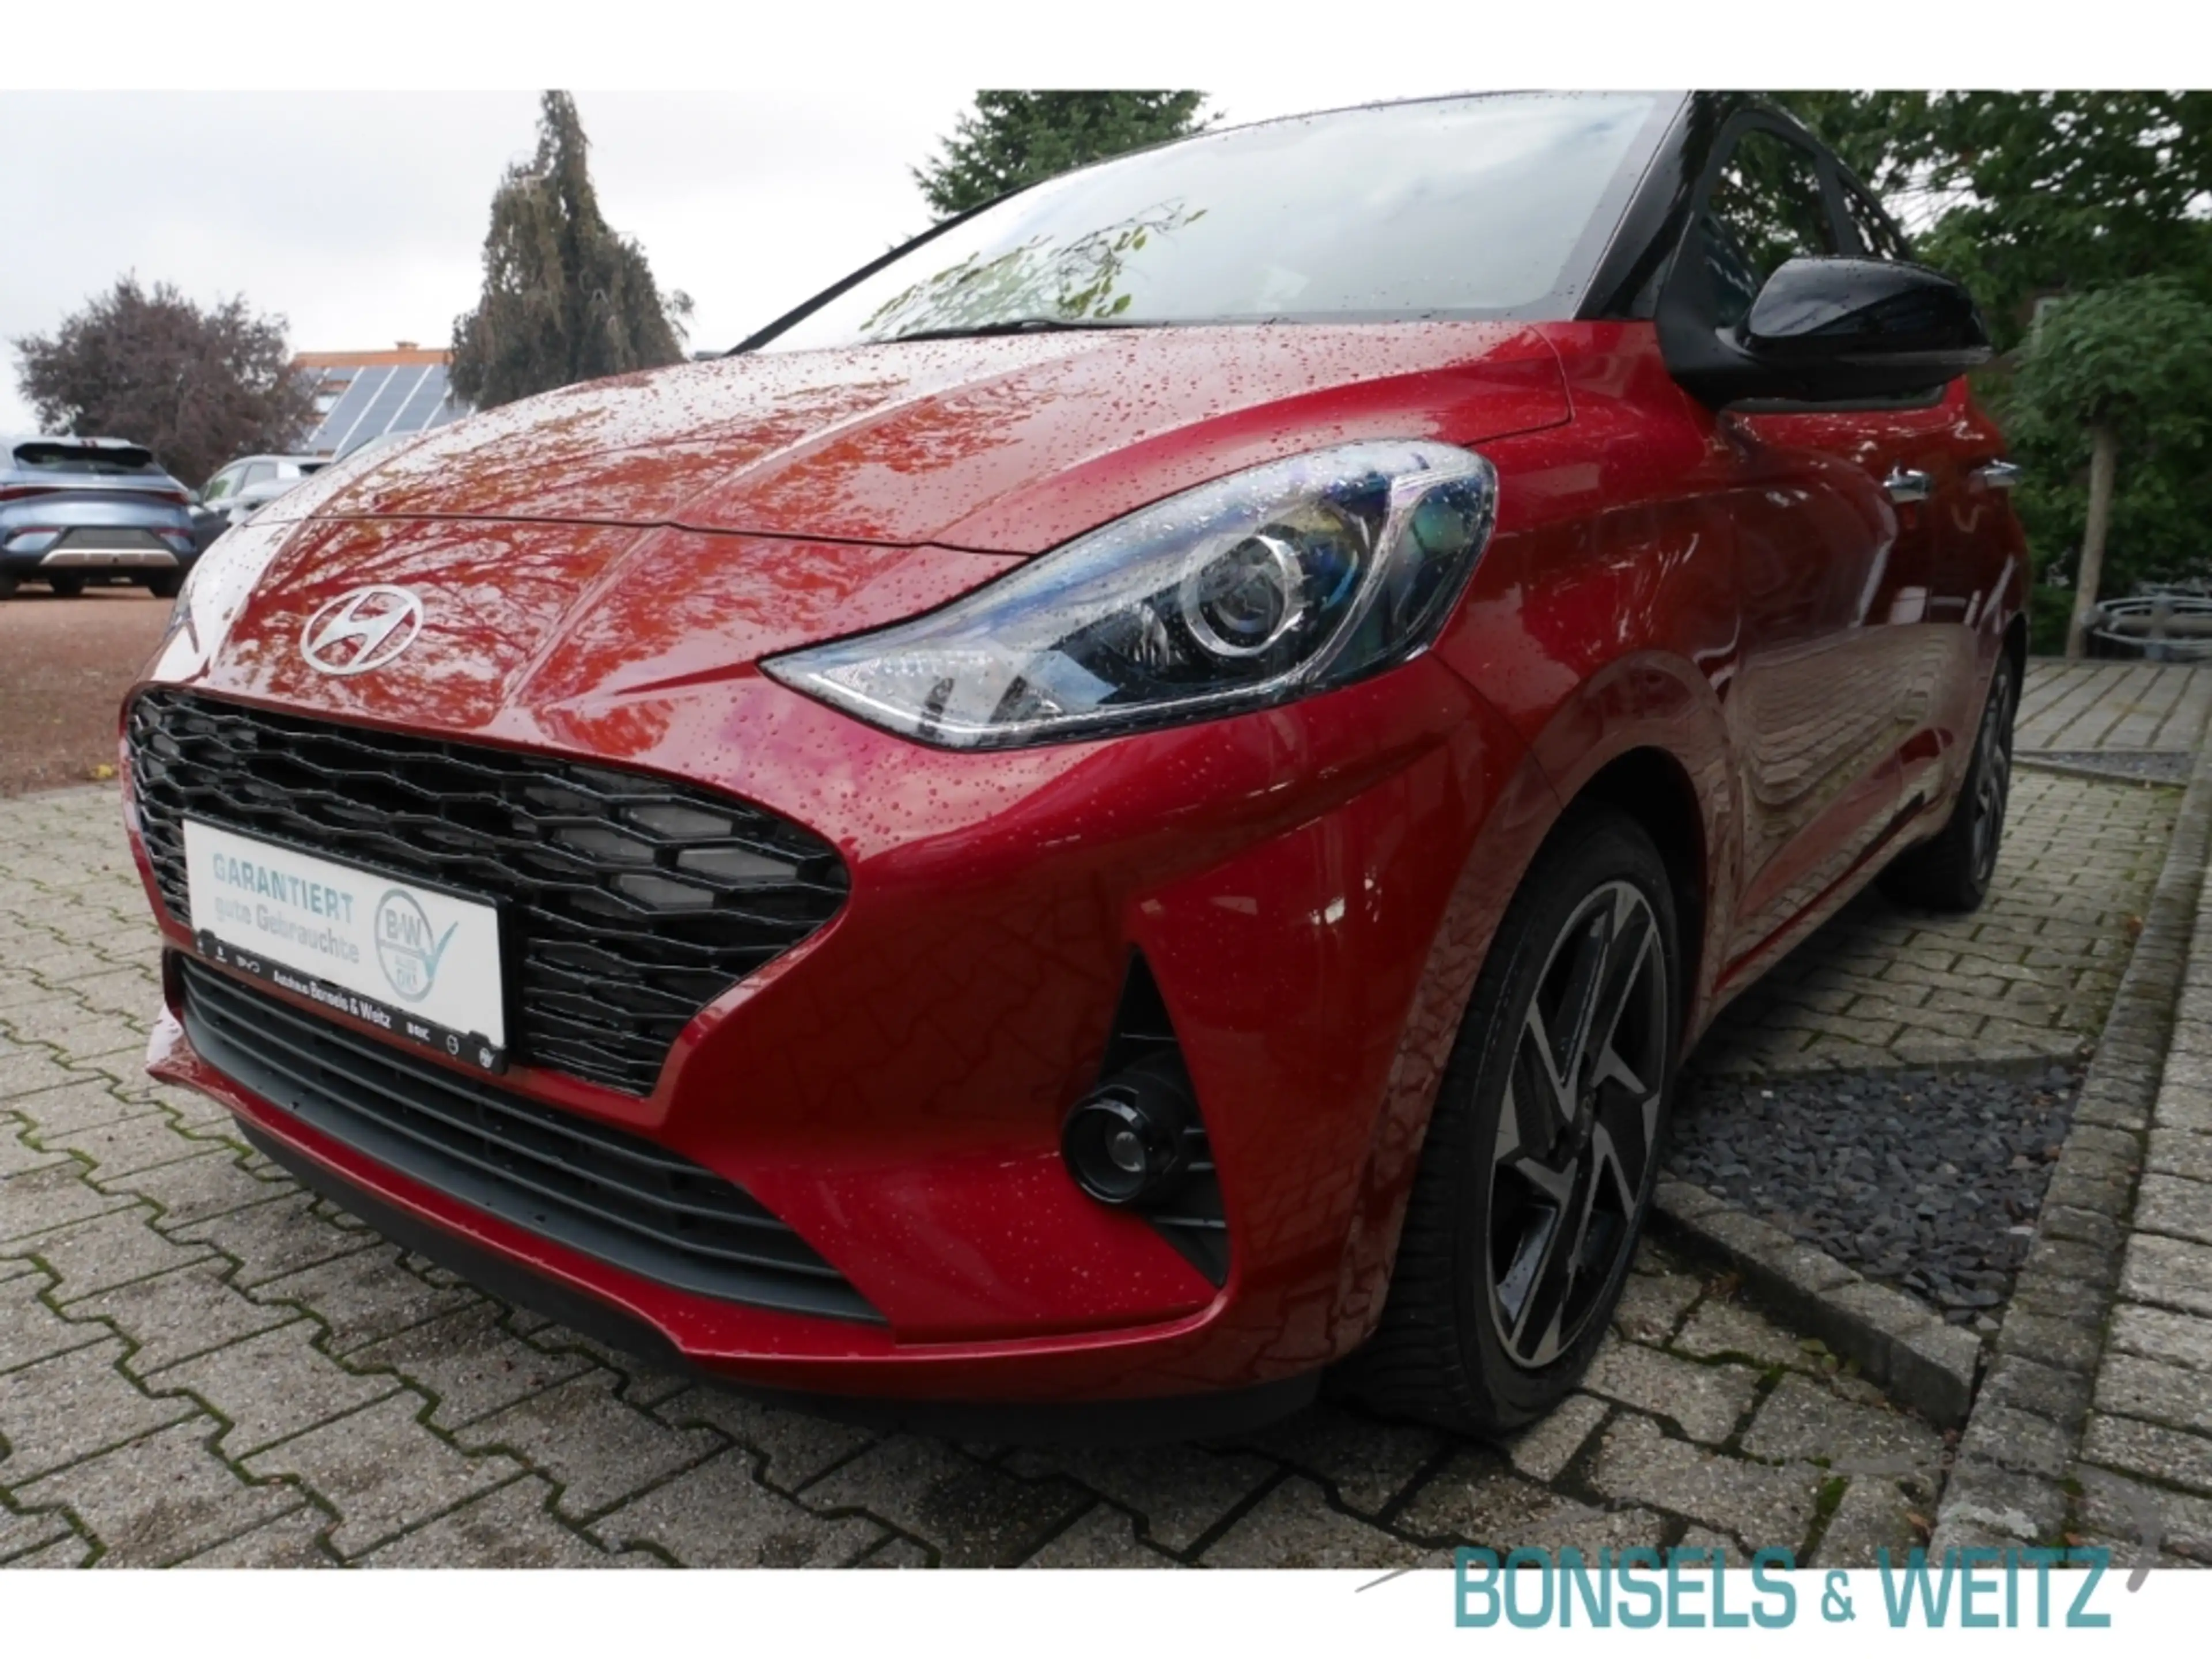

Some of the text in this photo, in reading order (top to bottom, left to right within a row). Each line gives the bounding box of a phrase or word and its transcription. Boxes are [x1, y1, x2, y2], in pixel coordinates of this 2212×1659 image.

[212, 853, 354, 924] GARANTIERT
[214, 896, 360, 964] gute Gebrauchte
[349, 997, 359, 1017] &
[359, 1000, 392, 1029] Weitz
